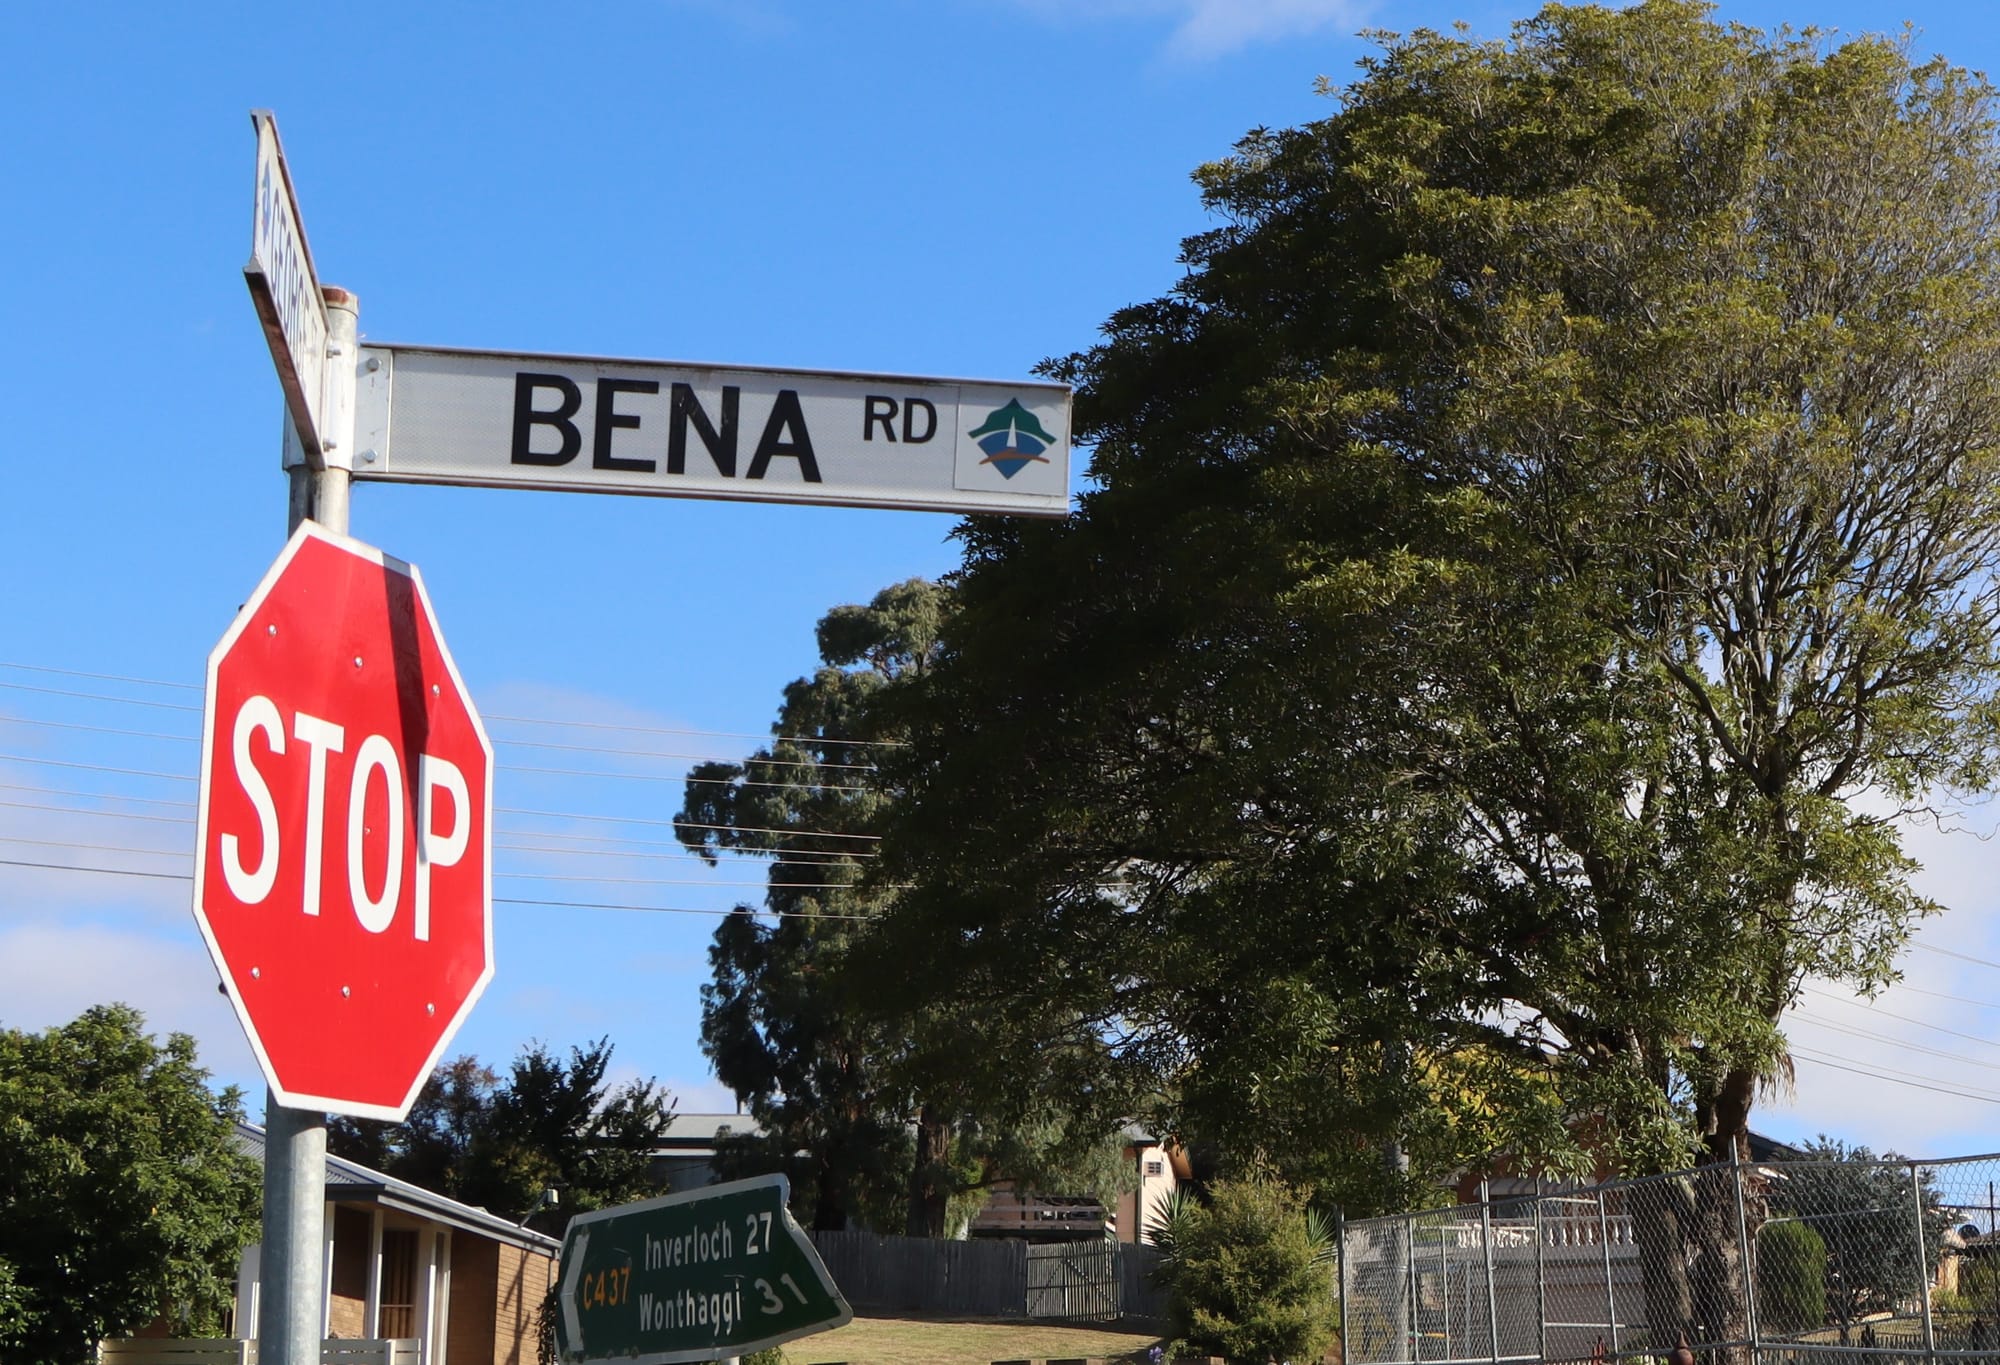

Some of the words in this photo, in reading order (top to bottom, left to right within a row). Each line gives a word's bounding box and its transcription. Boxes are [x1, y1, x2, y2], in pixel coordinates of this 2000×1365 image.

[271, 187, 310, 387] GEORGE
[511, 372, 822, 483] BENA
[863, 395, 938, 444] RD
[221, 695, 470, 942] STOP
[645, 1220, 732, 1272] Inverloch
[746, 1211, 773, 1255] 27
[584, 1267, 631, 1311] C437
[639, 1280, 742, 1336] Wonthaggi
[755, 1273, 808, 1315] 31
